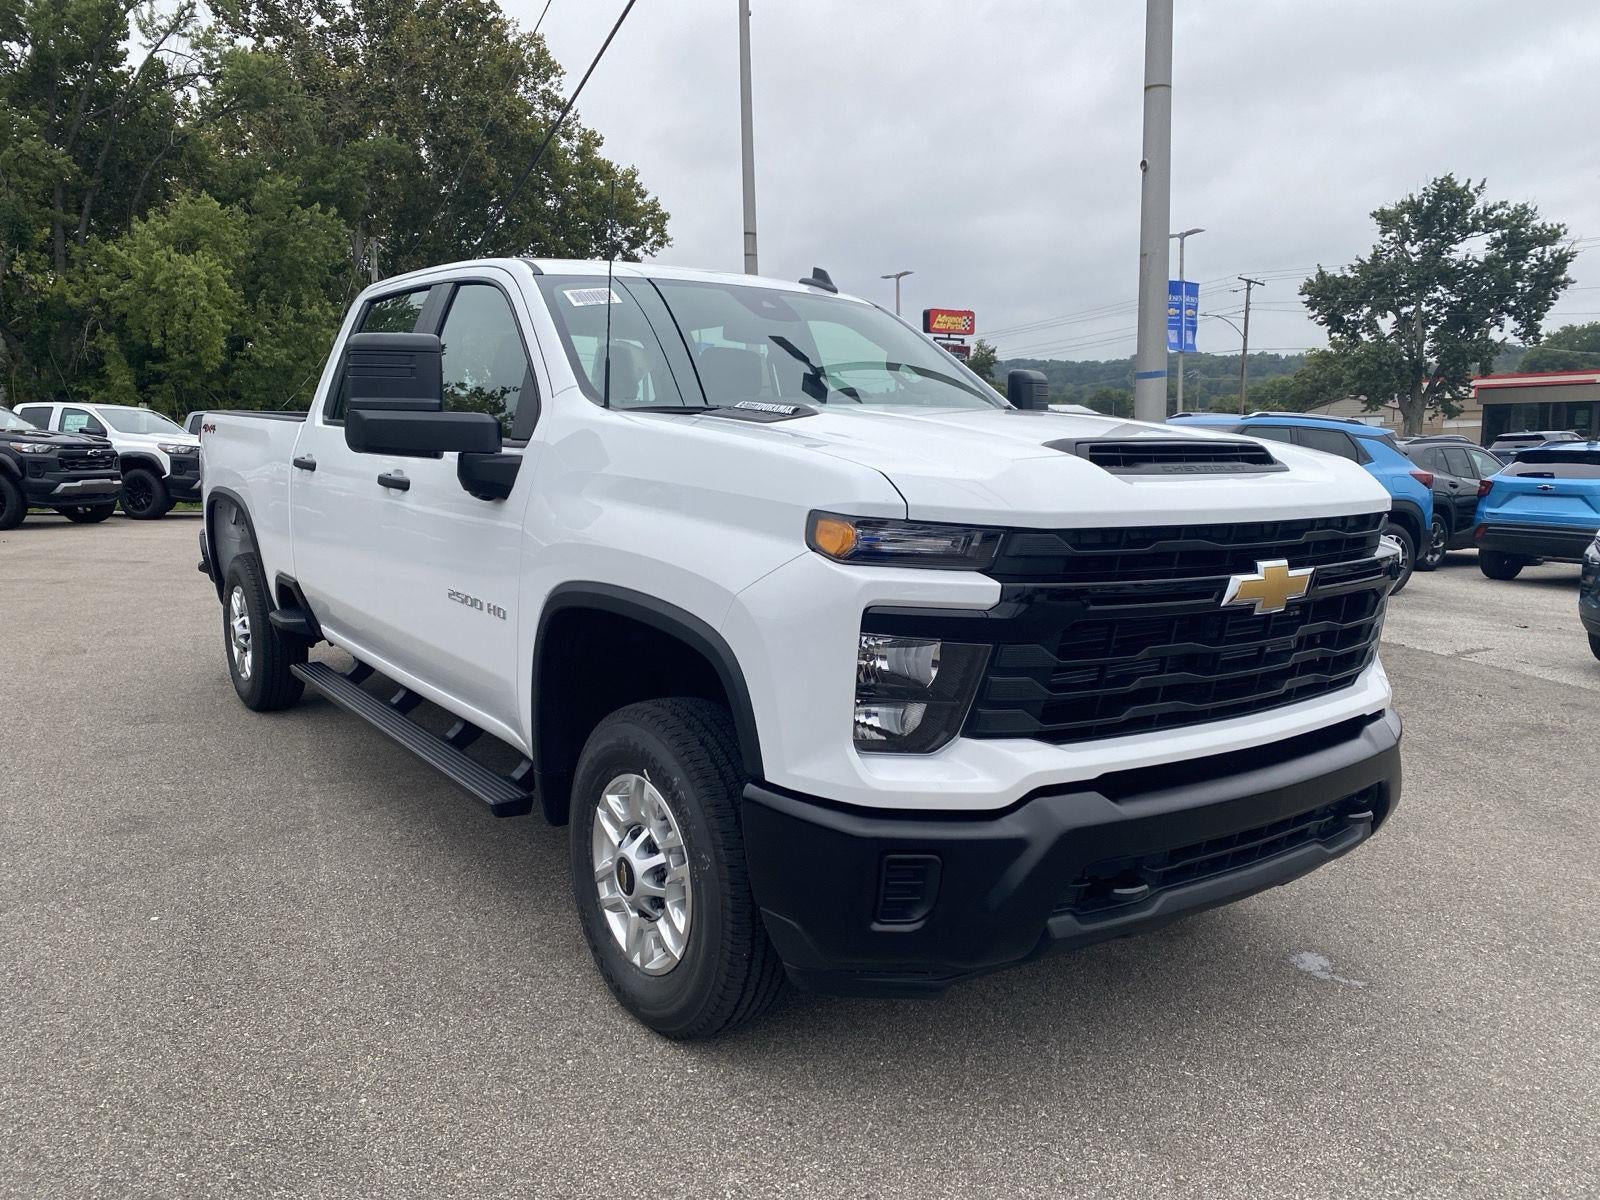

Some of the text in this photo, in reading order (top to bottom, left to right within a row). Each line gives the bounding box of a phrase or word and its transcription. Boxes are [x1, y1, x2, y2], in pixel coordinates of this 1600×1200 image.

[936, 313, 963, 323] Advance
[946, 322, 963, 330] Parts
[1161, 464, 1246, 473] CHEVROLET
[447, 588, 507, 620] 2500 HD
